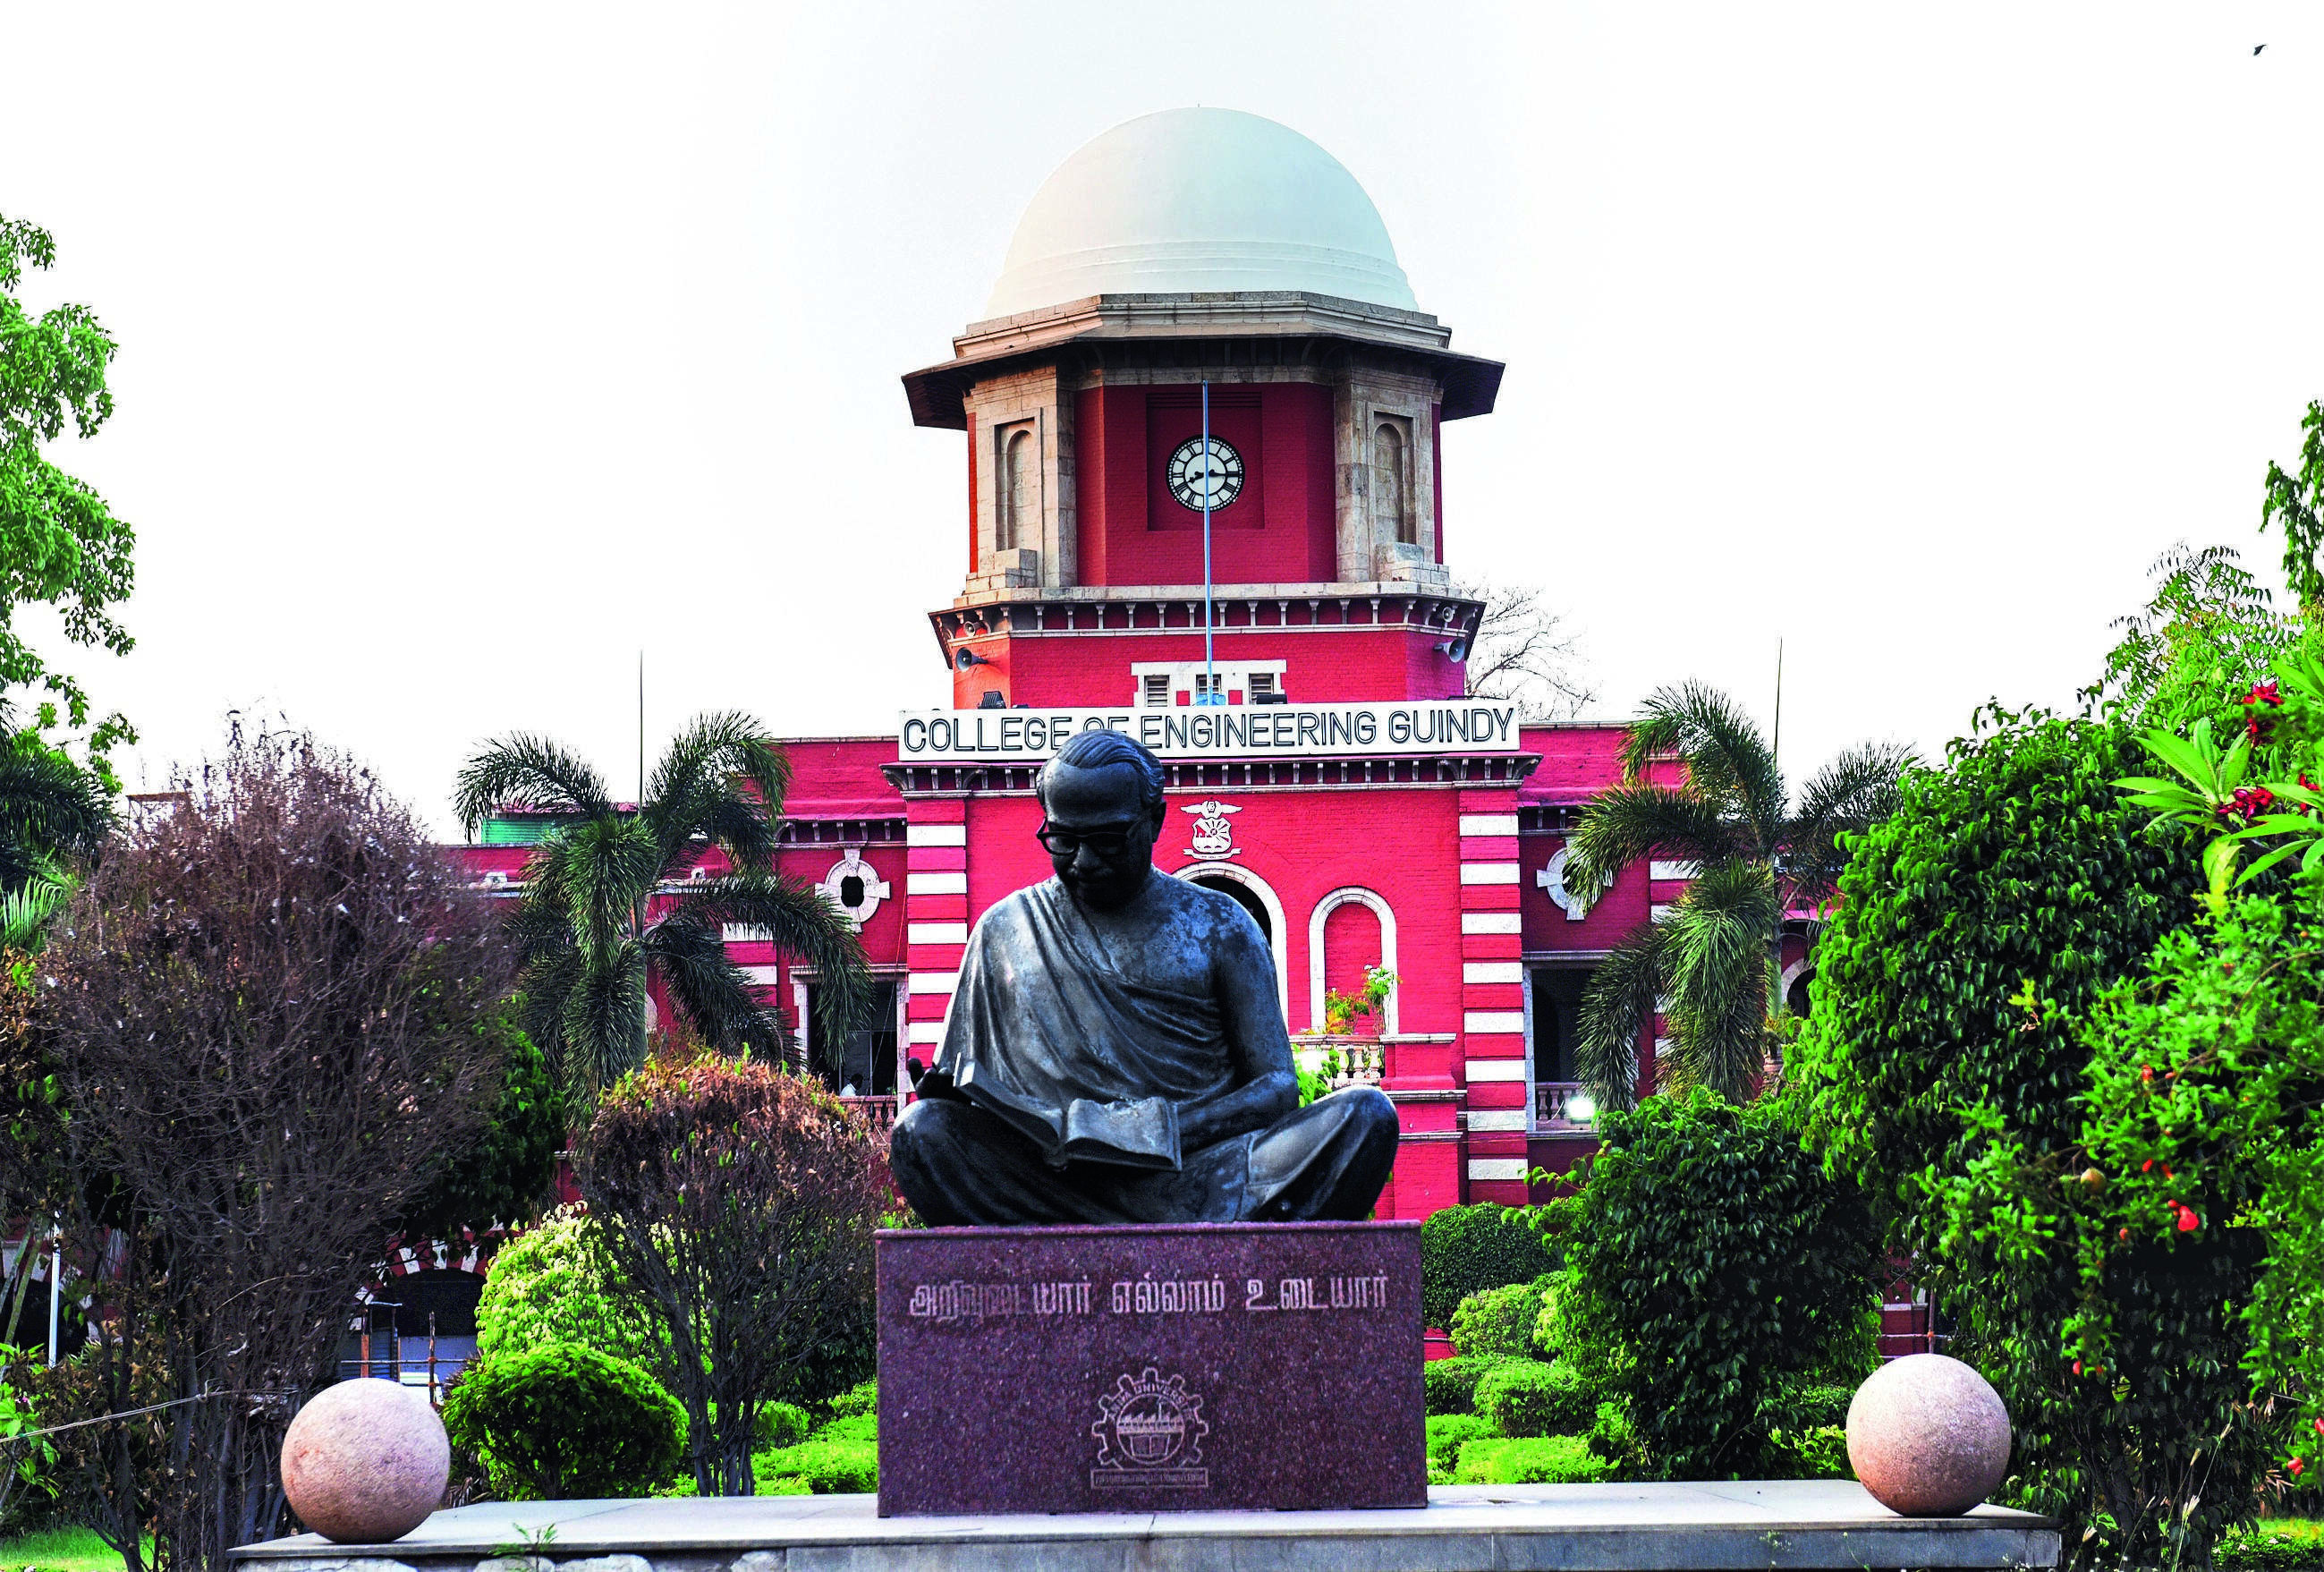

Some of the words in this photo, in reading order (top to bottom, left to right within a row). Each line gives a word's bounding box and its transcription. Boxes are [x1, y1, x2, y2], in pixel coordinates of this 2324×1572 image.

[904, 717, 1072, 752] COLLEGE
[1141, 710, 1377, 749] ENGINEERING
[1388, 708, 1514, 744] GUINDY
[1112, 1271, 1226, 1313] எல்லாம்
[1245, 1269, 1388, 1310] உடையார்
